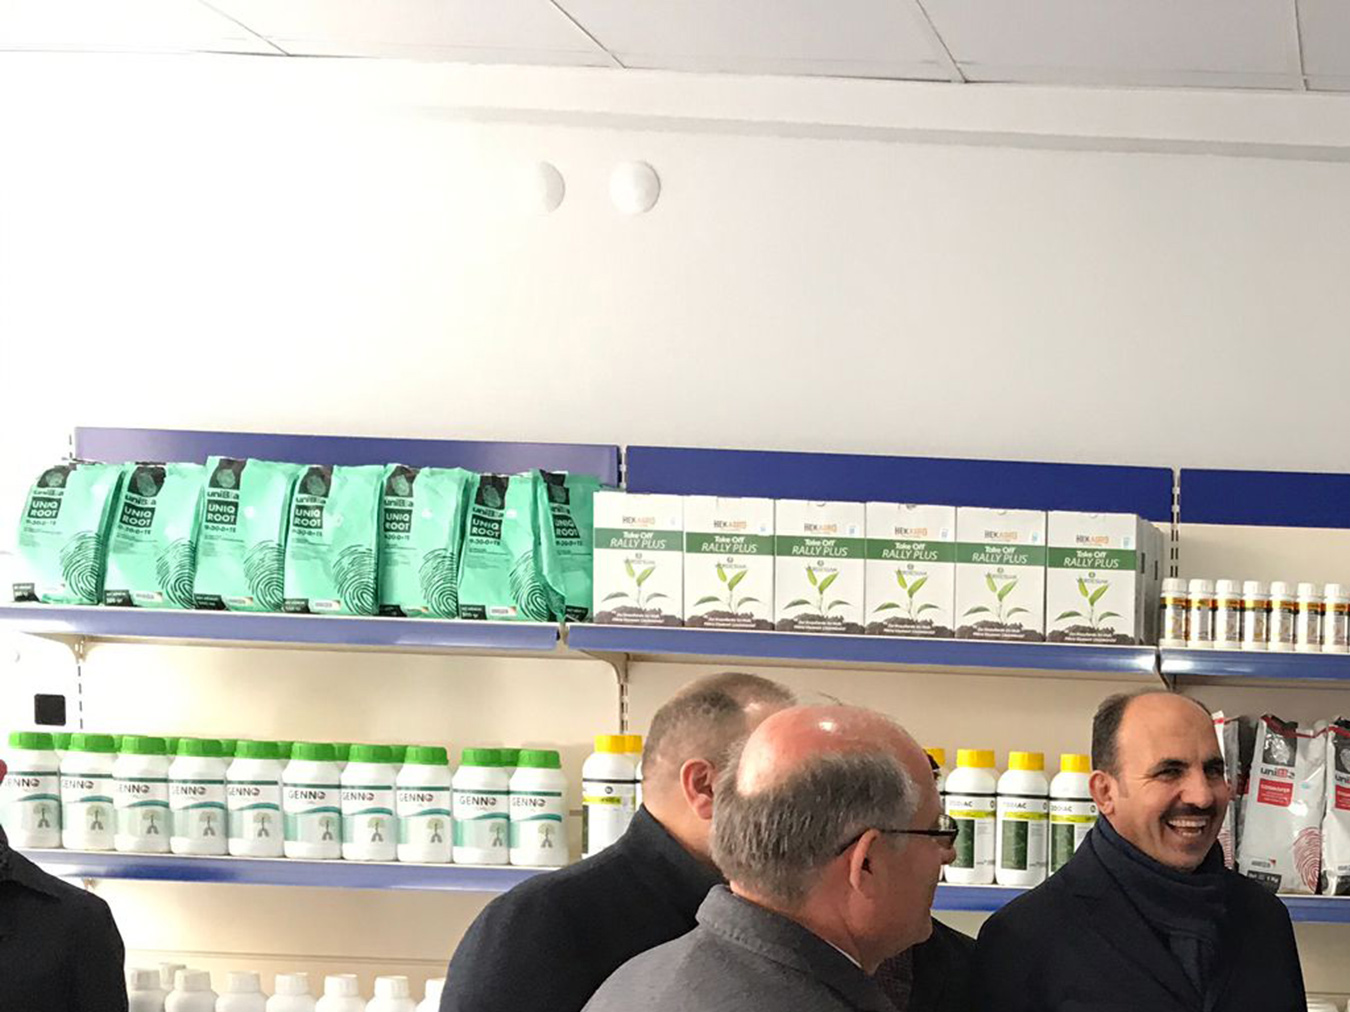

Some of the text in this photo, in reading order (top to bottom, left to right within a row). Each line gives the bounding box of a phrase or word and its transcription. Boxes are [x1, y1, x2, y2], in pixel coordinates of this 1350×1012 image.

[32, 500, 58, 509] UNIQ
[208, 503, 235, 514] UNIQ
[30, 508, 57, 518] ROOT
[125, 505, 152, 518] UNIQ
[295, 507, 320, 517] UNIQ
[122, 514, 151, 527] ROOT
[207, 513, 235, 523] ROOT
[386, 512, 410, 522] UNIQ
[294, 518, 321, 527] ROOT
[473, 517, 500, 530] UNIQ
[471, 526, 501, 538] ROOT
[555, 527, 577, 537] ROOT
[623, 531, 654, 540] Take Off
[610, 538, 667, 549] RALLY PLUS
[714, 535, 746, 544] Take Off
[804, 538, 836, 547] Take Off
[701, 542, 758, 554] RALLY PLUS
[895, 541, 926, 550] Take Off
[985, 545, 1016, 554] Take Off
[792, 546, 848, 557] RALLY PLUS
[882, 549, 938, 561] RALLY PLUS
[1076, 550, 1107, 559] Take Off
[972, 552, 1028, 564] RALLY PLUS
[1063, 557, 1120, 569] RALLY PLUS
